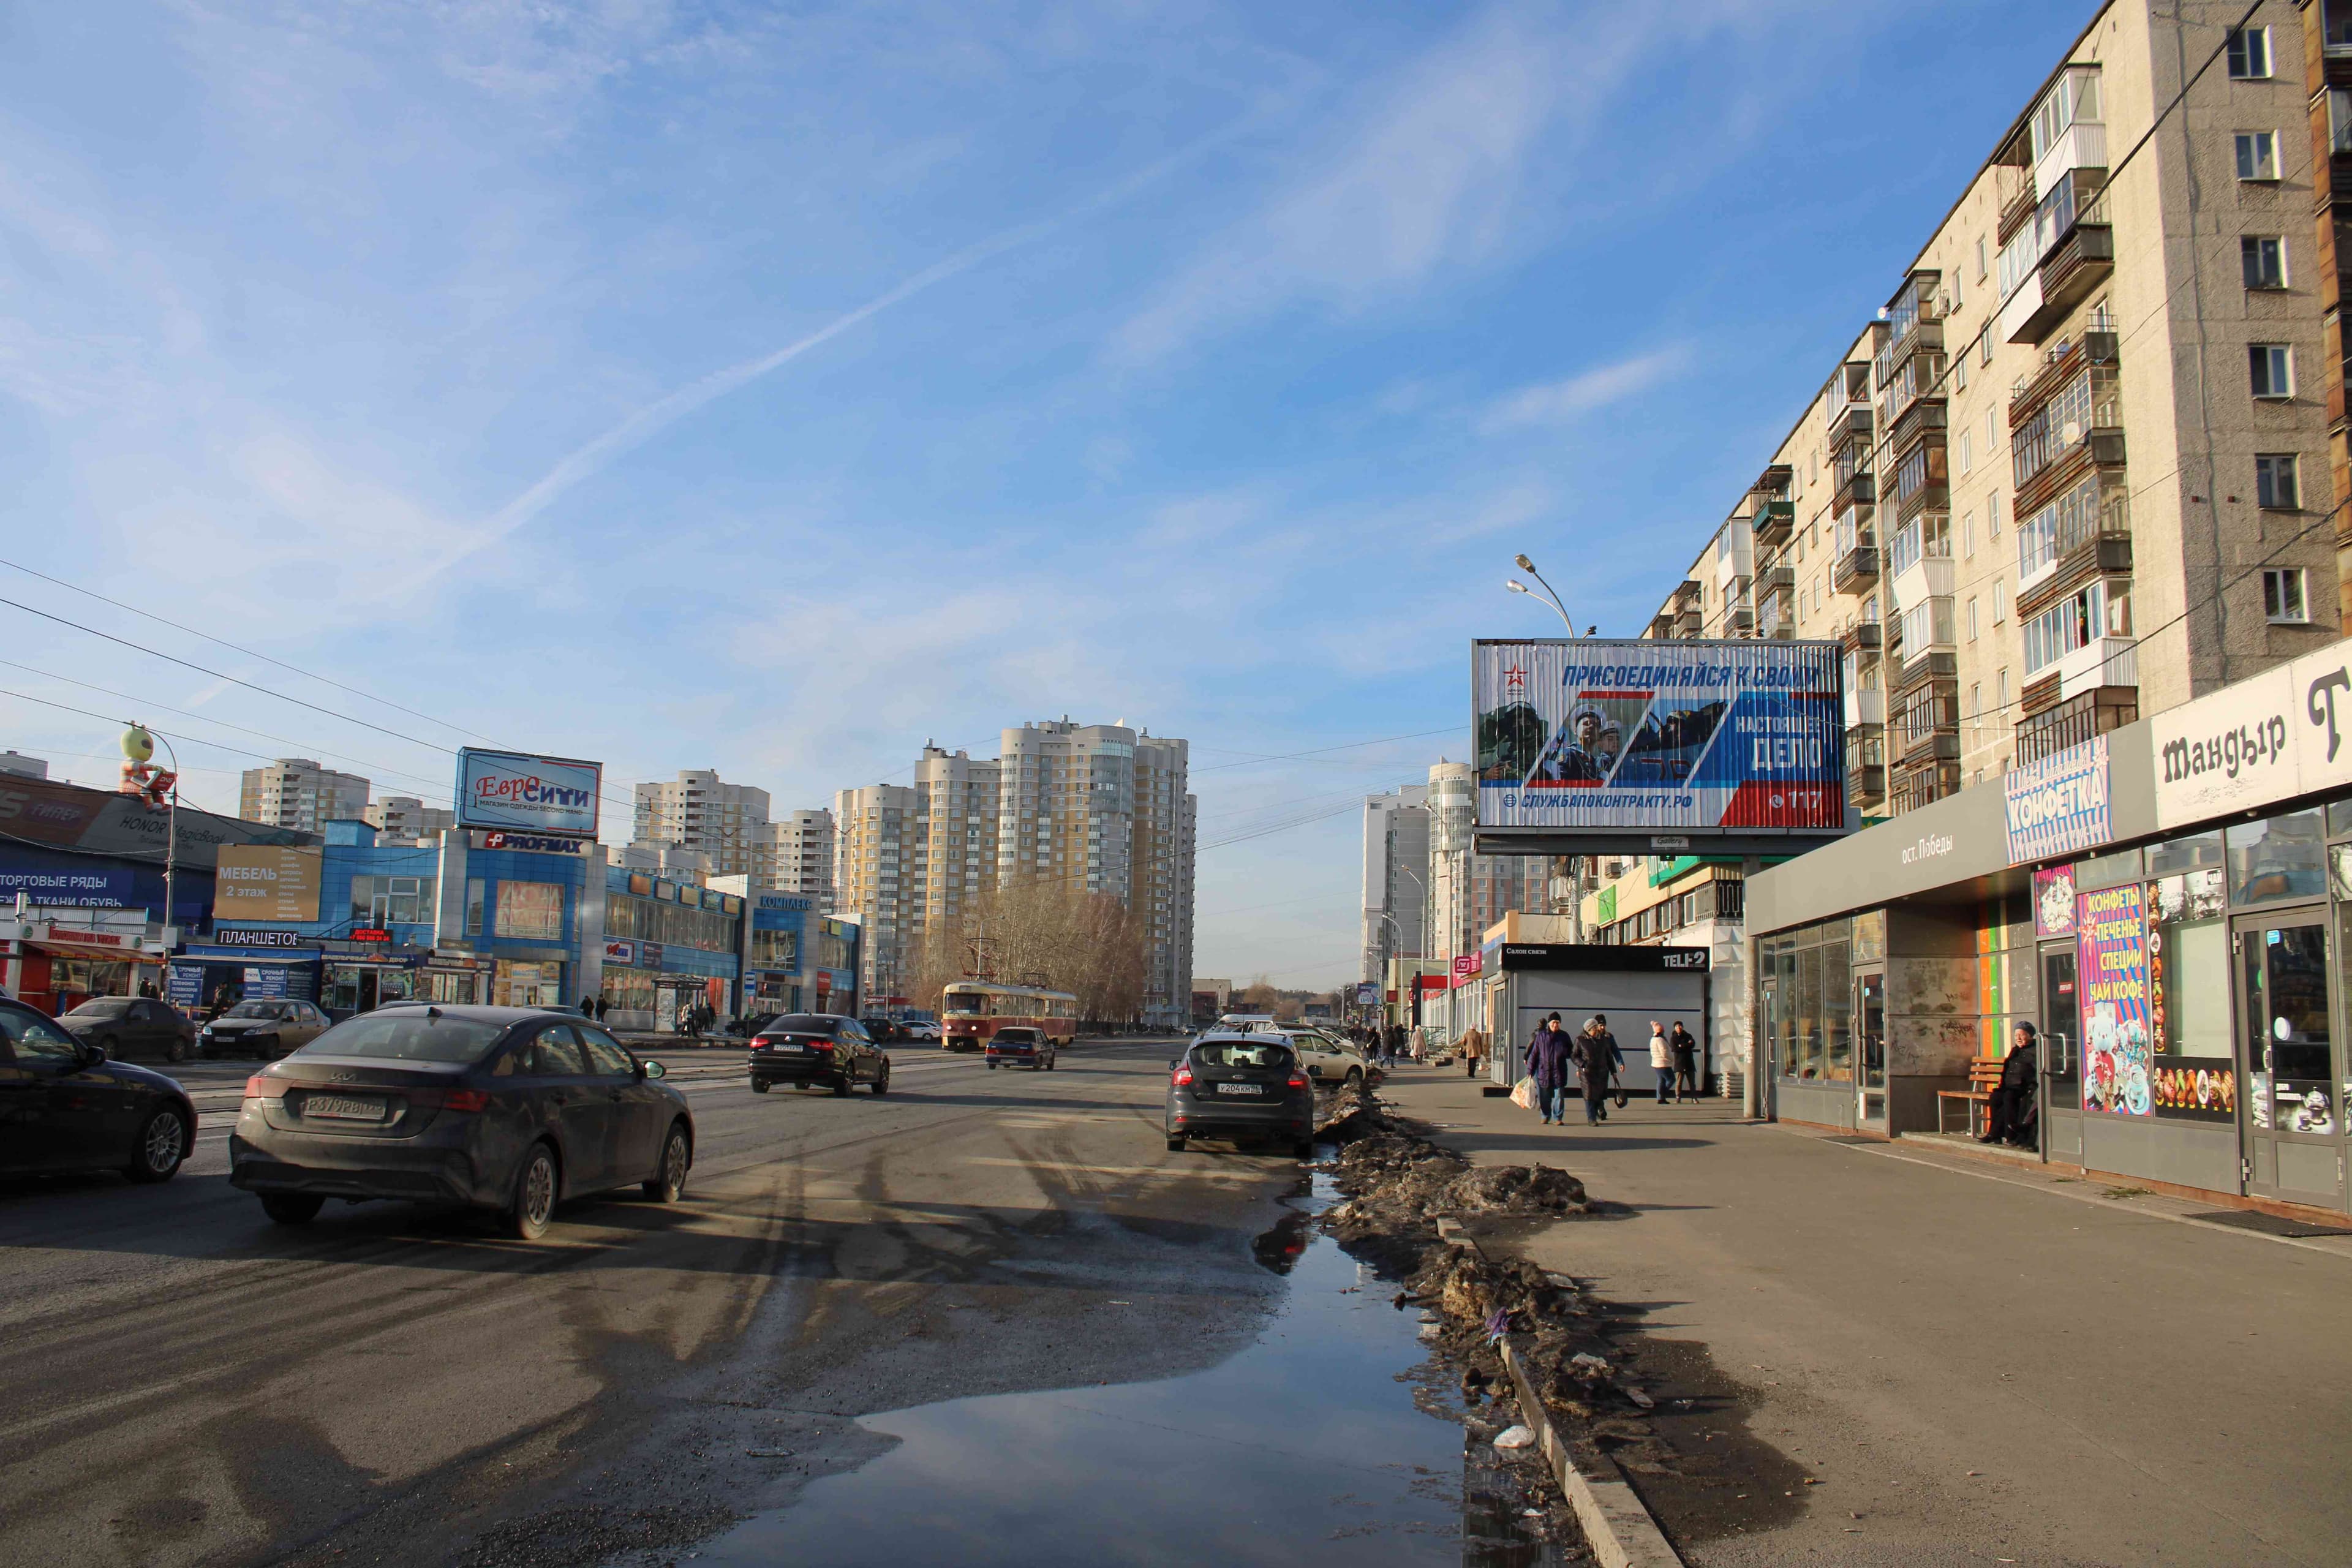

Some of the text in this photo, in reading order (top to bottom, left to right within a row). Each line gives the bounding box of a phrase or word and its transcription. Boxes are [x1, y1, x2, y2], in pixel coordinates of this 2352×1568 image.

[1562, 662, 1819, 688] ПРИСОЕДИНЯЙСЯ К СВОИМ
[1736, 716, 1820, 733] НАСТОЯЩЕЕ
[1752, 737, 1821, 771] ДЕЛО
[509, 803, 538, 812] ОДЕЖДЫ
[1521, 794, 1692, 809] СЛУЖБАПОКОНТРАКТУ.РФ
[1789, 791, 1823, 809] 117
[2010, 769, 2106, 832] КОНФЕТКА
[119, 817, 167, 834] HONOR
[505, 835, 584, 854] PROFMAX
[1657, 837, 1683, 846] Gallery
[1902, 834, 1953, 864] ост. Победы
[1, 875, 107, 889] ТОРГОВЫЕ РЯДЫ
[219, 867, 277, 880] МЕБЕЛЬ
[226, 886, 267, 897] 2 этаж
[2088, 886, 2140, 913] КОНФЕТЫ
[760, 895, 813, 910] КОМПЛЕКС
[2097, 918, 2141, 941] ПЕЧЕНЬЕ
[1663, 951, 1706, 968] TELE2
[2100, 949, 2143, 972] СПЕЦИИ
[2090, 978, 2144, 1001] ЧАЙ КОФЕ
